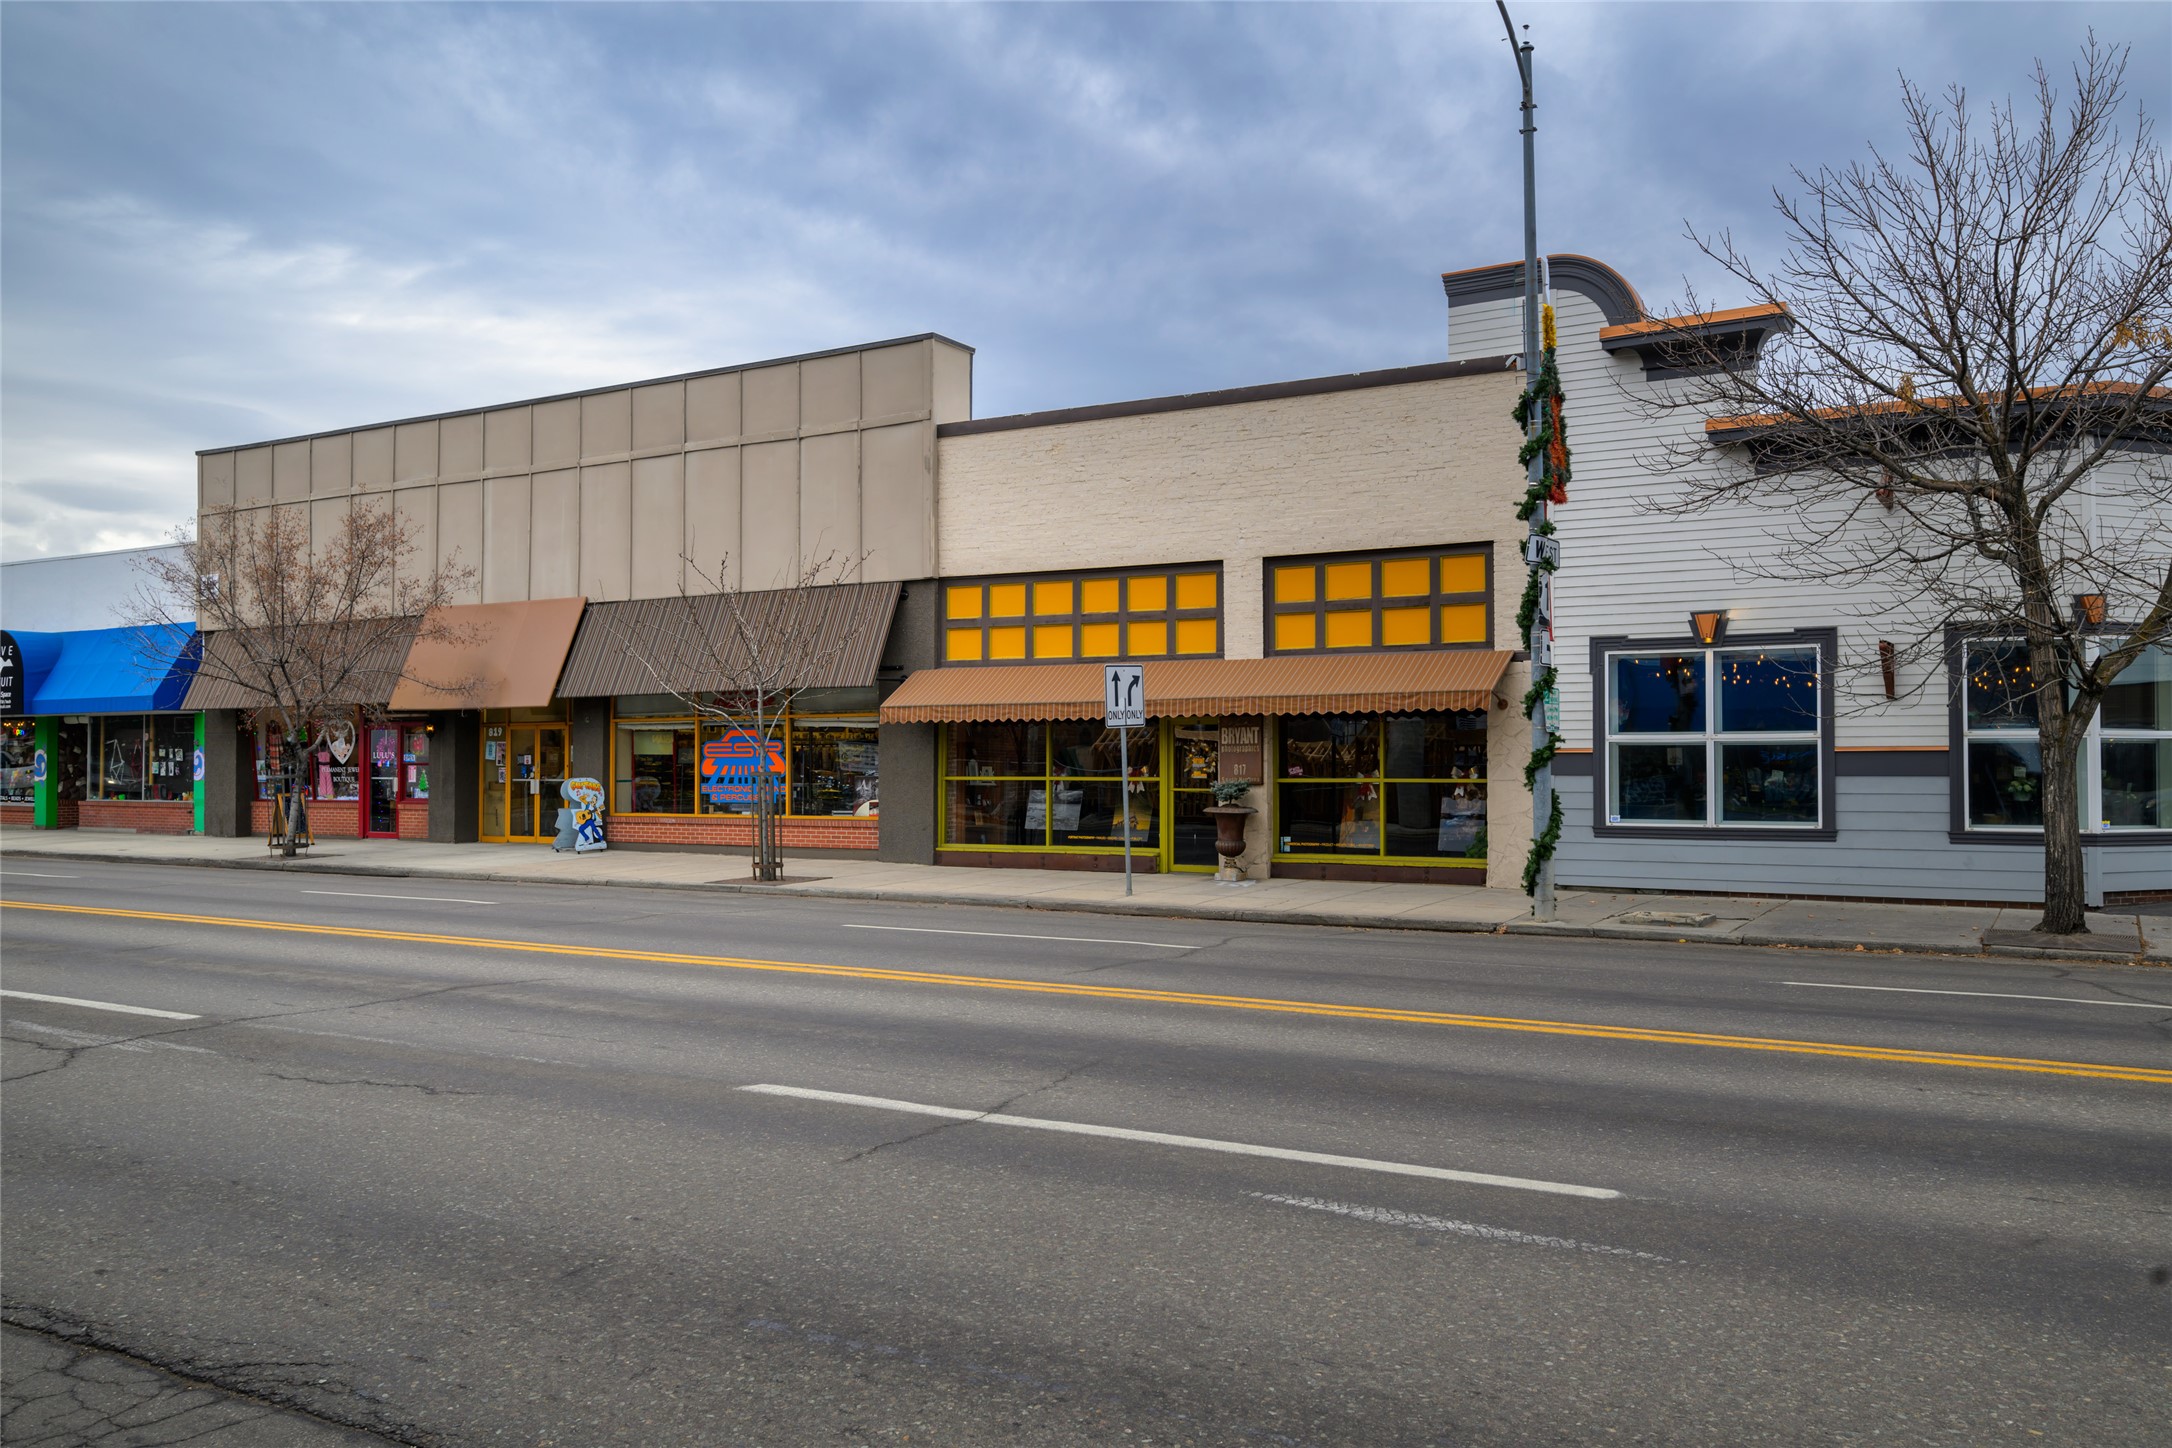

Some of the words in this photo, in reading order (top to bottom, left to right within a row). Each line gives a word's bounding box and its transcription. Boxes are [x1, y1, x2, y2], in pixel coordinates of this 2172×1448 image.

[1535, 539, 1557, 563] WEST
[0, 676, 13, 687] UIT
[1108, 710, 1125, 720] ONLY
[1126, 709, 1143, 719] ONLY
[488, 727, 502, 737] 819
[1221, 727, 1260, 744] BRYANT
[372, 751, 395, 759] LULU'S
[1233, 763, 1247, 776] 817
[333, 776, 355, 784] BOUTIQUE
[702, 785, 752, 793] ELECTRONIC
[712, 793, 718, 801] &
